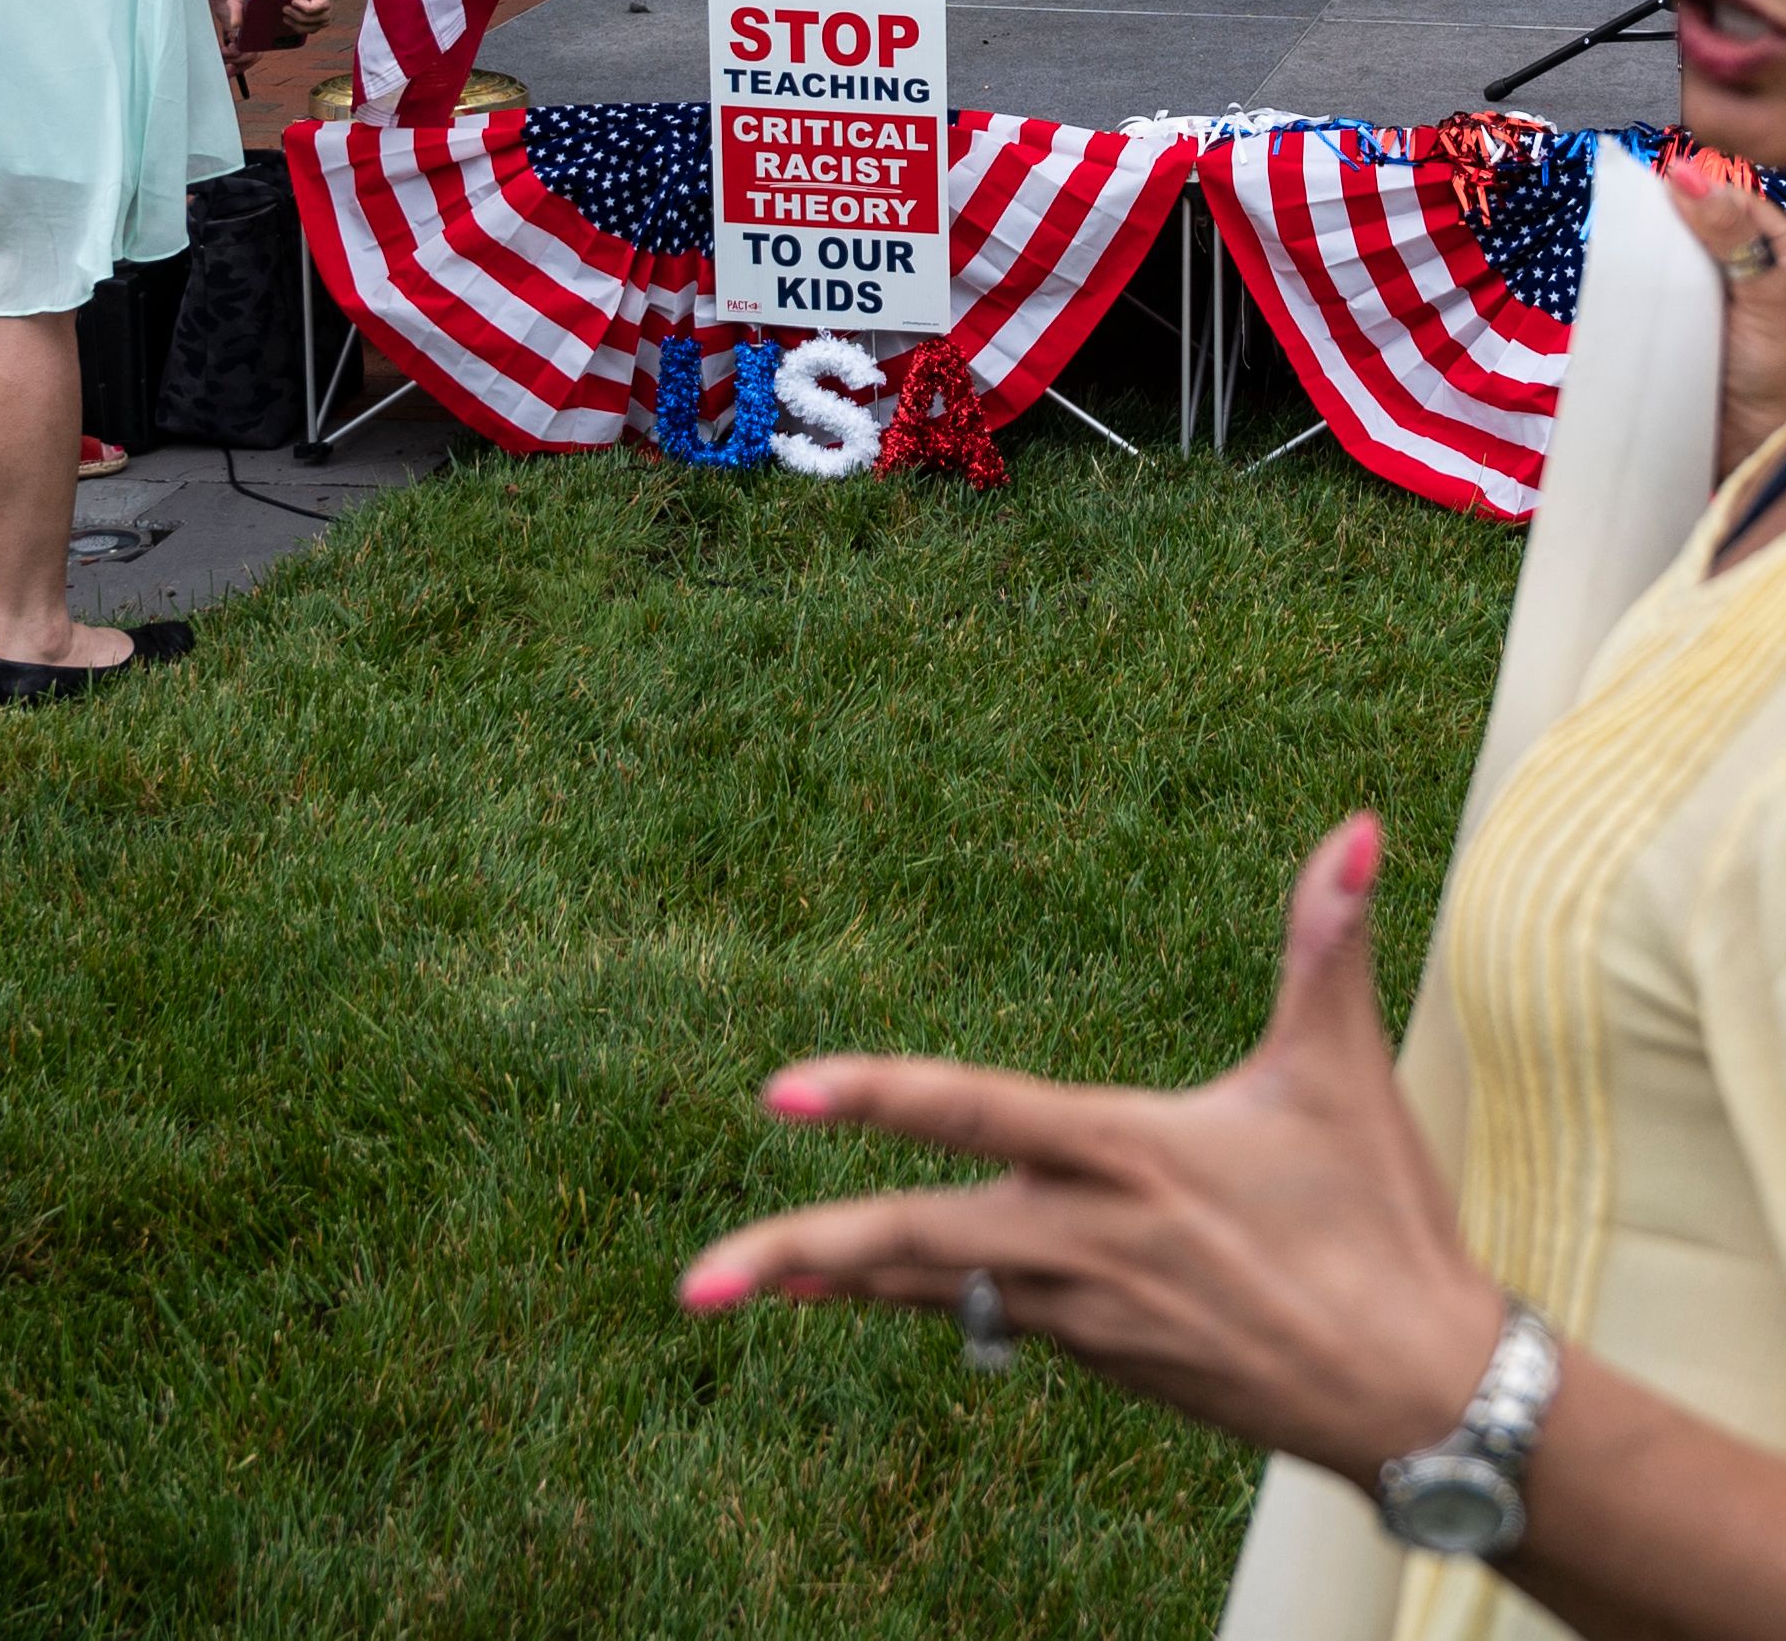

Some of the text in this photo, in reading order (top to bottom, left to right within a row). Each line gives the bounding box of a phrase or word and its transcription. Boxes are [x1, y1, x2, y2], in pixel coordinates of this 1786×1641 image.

[729, 6, 920, 69] STOP
[723, 67, 931, 104] TEACHING
[733, 114, 929, 151] CRITICAL
[755, 151, 907, 186] RACIST
[746, 190, 918, 227] THEORY
[742, 232, 916, 274] TO OUR
[777, 275, 884, 314] KIDS
[655, 331, 1012, 492] USA
